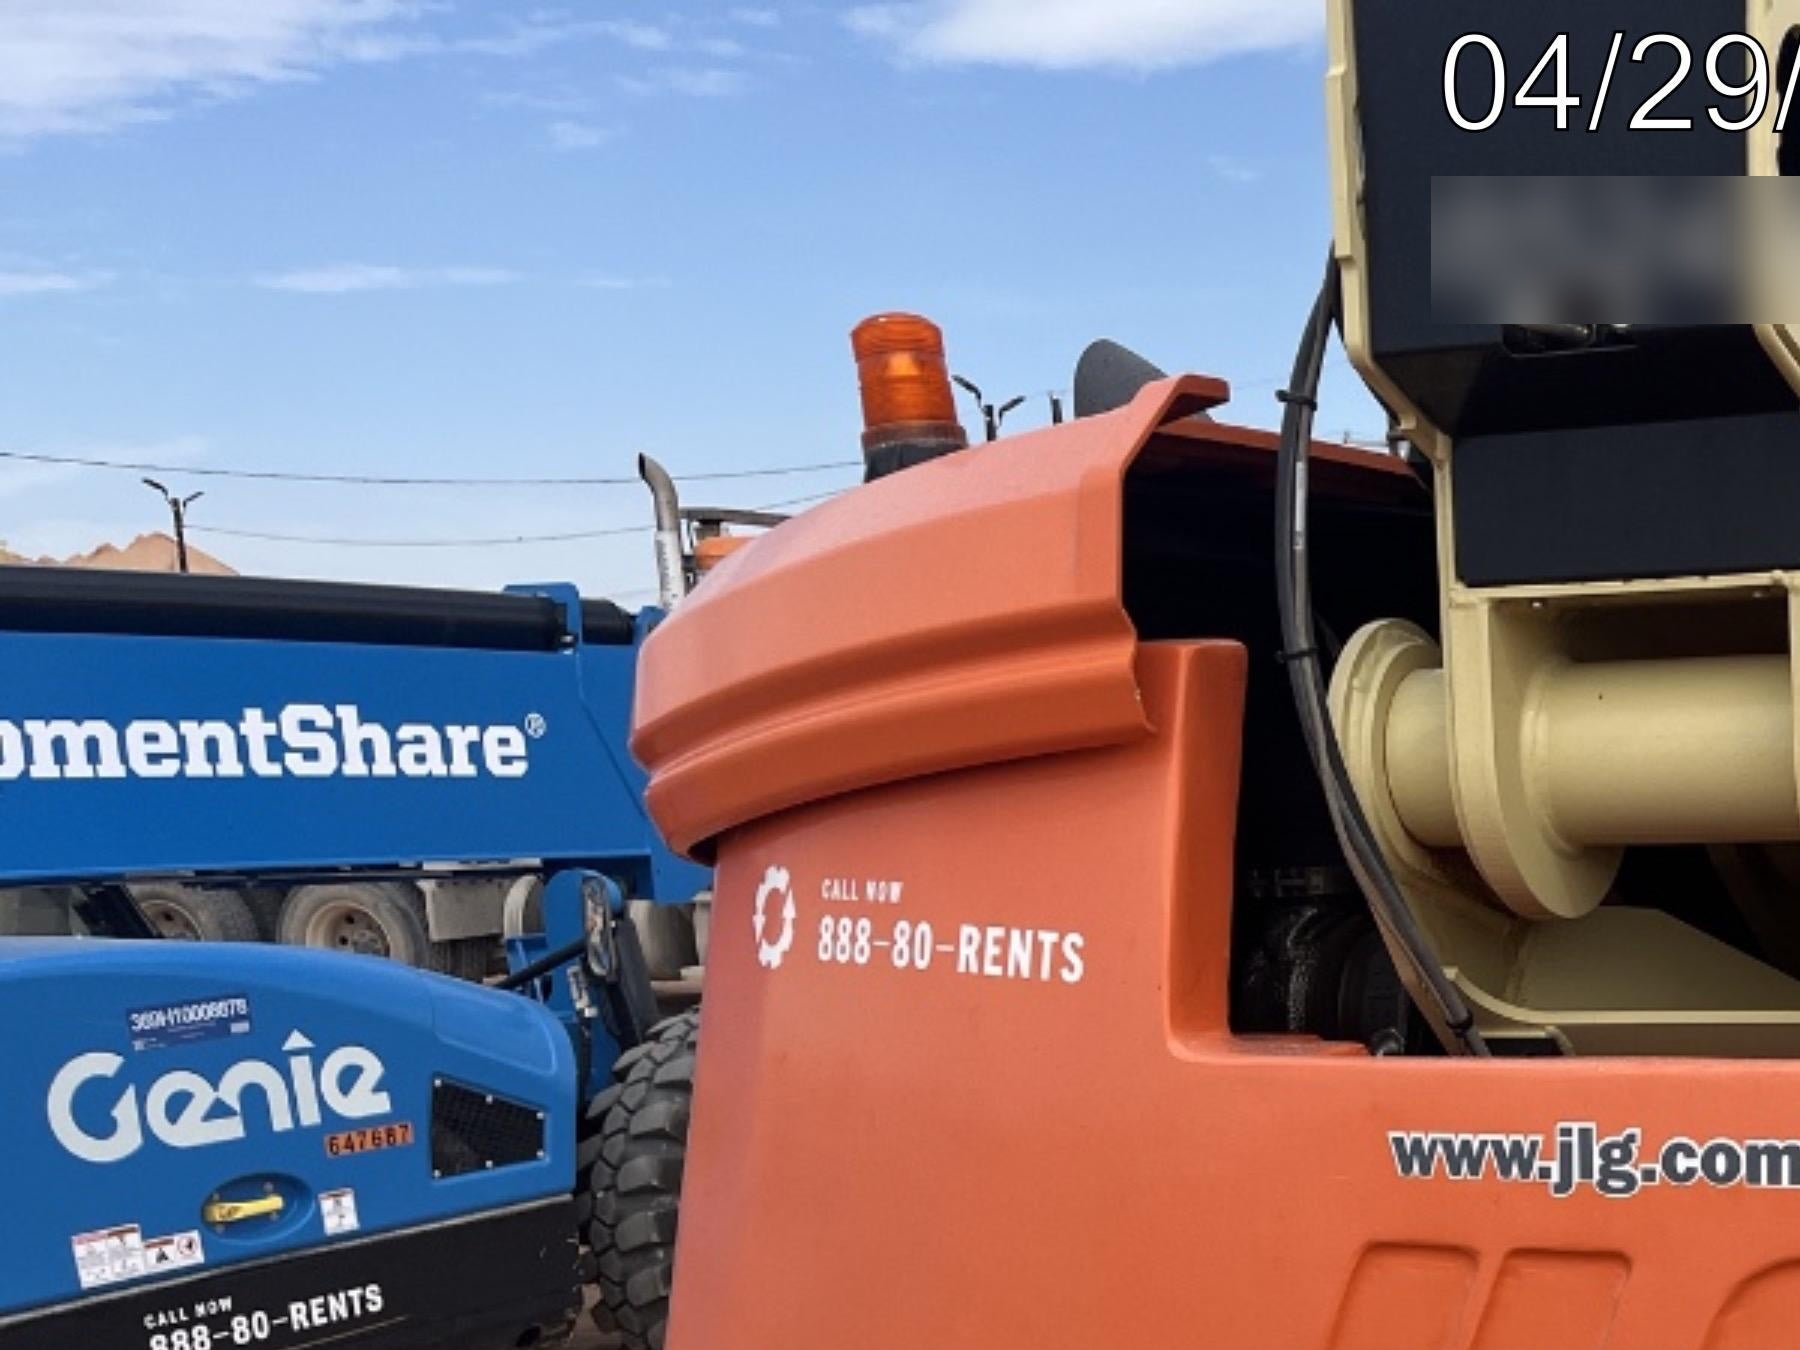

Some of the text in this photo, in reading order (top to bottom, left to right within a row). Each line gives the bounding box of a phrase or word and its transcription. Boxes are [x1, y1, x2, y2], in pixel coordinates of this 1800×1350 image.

[821, 878, 904, 903] CALL NOW
[817, 914, 1085, 984] 888-80-RENTS
[47, 1029, 391, 1163] Genie
[143, 1296, 233, 1329] CALL NOW
